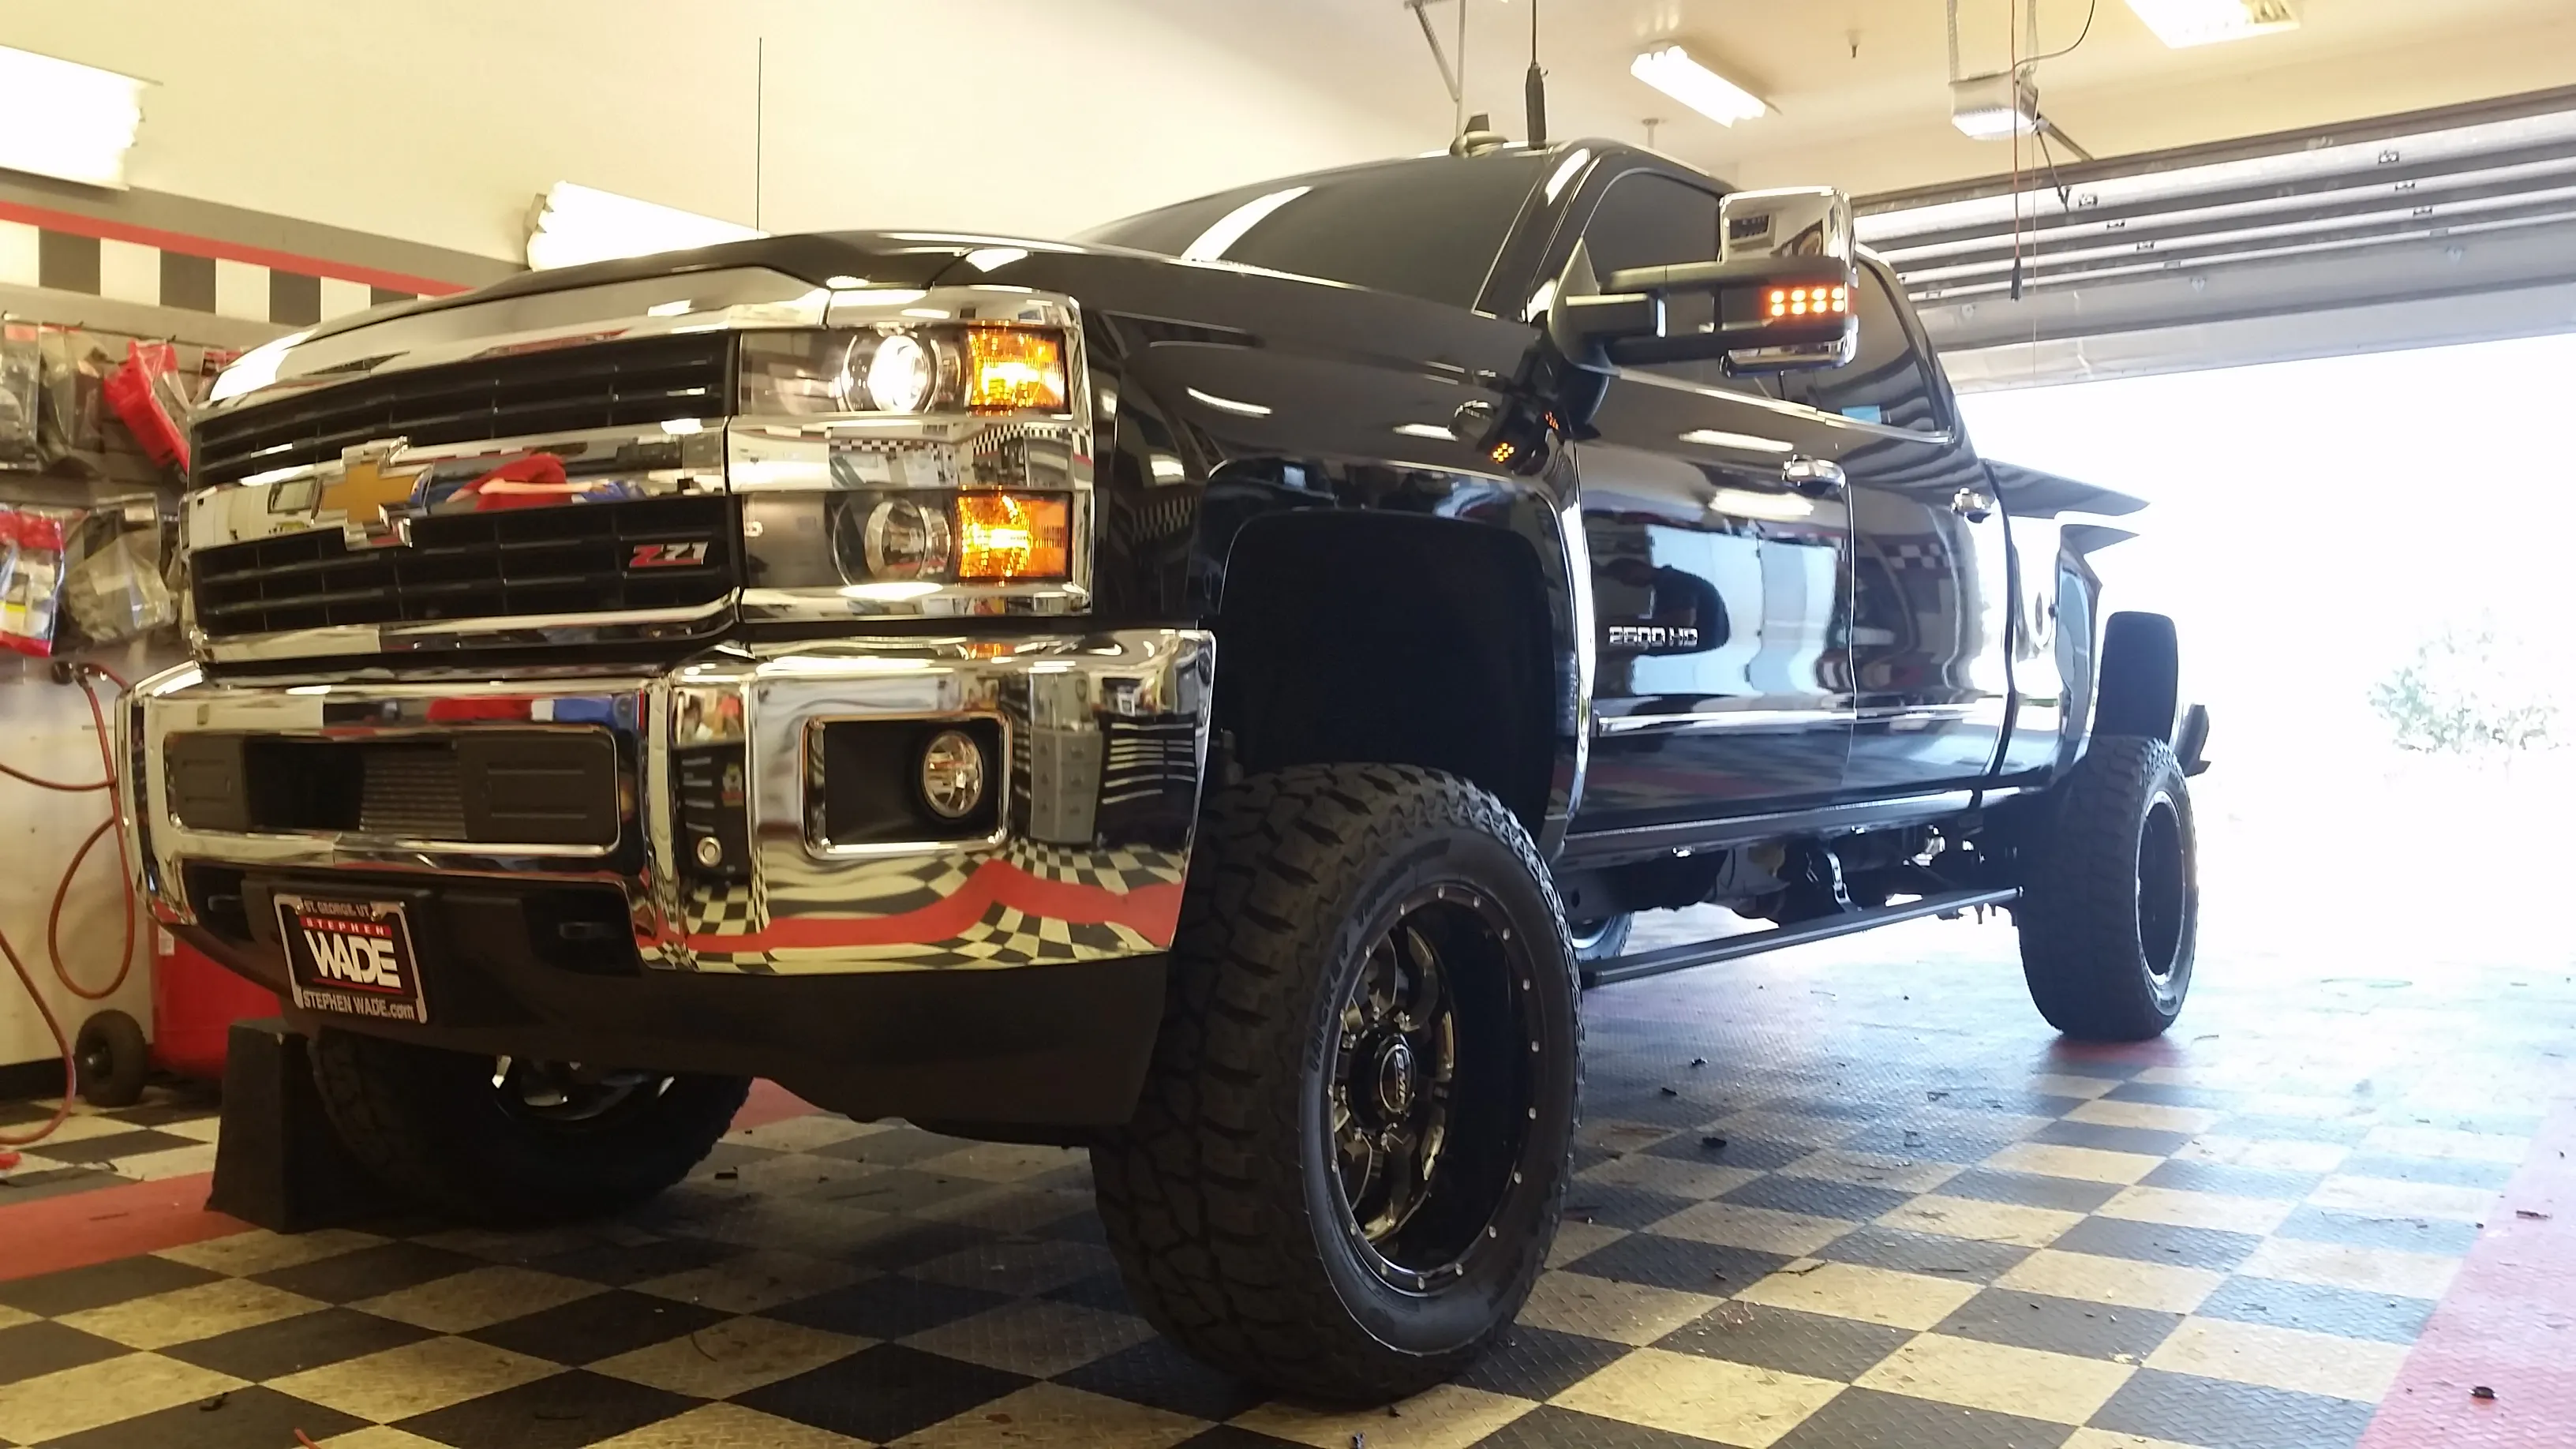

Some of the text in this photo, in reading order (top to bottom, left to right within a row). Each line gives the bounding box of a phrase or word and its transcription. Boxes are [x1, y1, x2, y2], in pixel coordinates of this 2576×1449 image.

[629, 541, 709, 567] Z71
[1608, 626, 1698, 647] 2500 HD
[355, 904, 370, 918] UT
[306, 917, 384, 936] STEPHEN
[303, 929, 402, 988] WADE
[303, 990, 415, 1020] STEPHEN WADE.com
